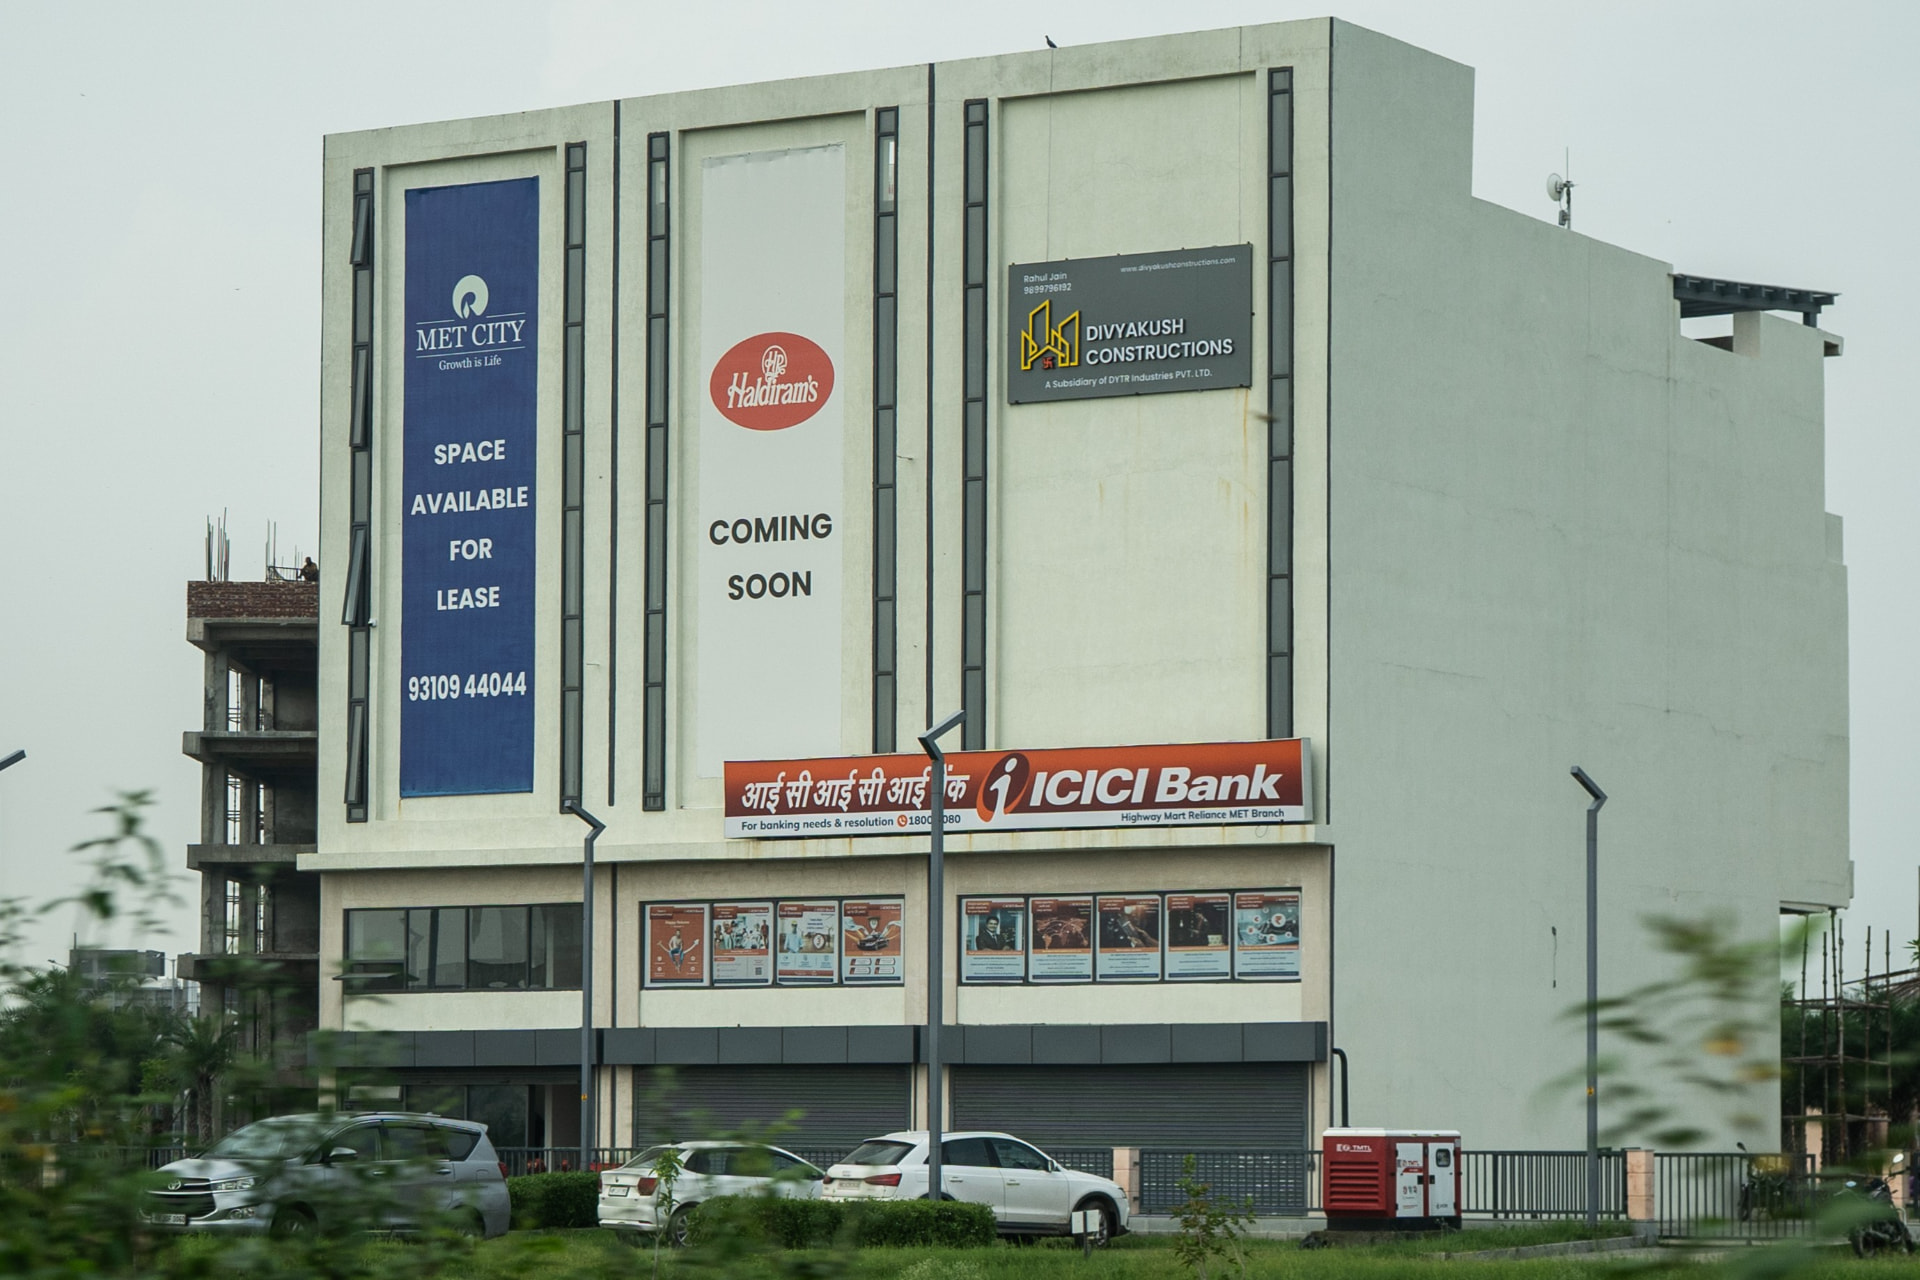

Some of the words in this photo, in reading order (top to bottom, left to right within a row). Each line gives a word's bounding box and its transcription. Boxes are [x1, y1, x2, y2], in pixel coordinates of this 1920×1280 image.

[1023, 272, 1048, 283] Rahul
[1049, 271, 1068, 281] Jain
[1120, 257, 1235, 272] www.divyakushconstructions.com
[416, 326, 467, 351] MET
[471, 319, 526, 346] CITY
[1086, 318, 1185, 341] DIVYAKUSH
[439, 357, 473, 371] Growth
[474, 356, 482, 368] is
[484, 354, 502, 367] Life
[1086, 338, 1233, 365] CONSTRUCTIONS
[727, 371, 818, 409] Haldiram's
[1044, 381, 1052, 389] A
[1052, 377, 1097, 389] Subsidiary
[1098, 375, 1108, 385] of
[1108, 373, 1130, 384] DYTR
[1131, 371, 1174, 382] Industries
[1175, 369, 1194, 379] PVT.
[1195, 368, 1213, 378] LTD.
[434, 439, 506, 465] SPACE
[410, 486, 529, 515] AVAILABLE
[709, 513, 833, 545] COMING
[450, 538, 492, 561] FOR
[437, 586, 500, 610] LEASE
[728, 571, 812, 600] SOON
[408, 675, 461, 701] 93109
[464, 671, 527, 698] 44044
[741, 771, 786, 814] आई
[785, 769, 813, 809] सी
[813, 768, 858, 812] आई
[858, 766, 887, 807] सी
[886, 765, 932, 810] आई
[1029, 767, 1150, 807] ICICI
[1155, 764, 1283, 803] Bank
[741, 821, 757, 831] For
[760, 819, 800, 831] banking
[803, 818, 832, 828] needs
[834, 818, 842, 828] &
[844, 816, 894, 827] resolution
[1121, 812, 1162, 823] Highway
[1164, 811, 1186, 820] Mart
[1188, 810, 1226, 820] Reliance
[1229, 809, 1249, 819] MET
[1251, 808, 1284, 818] Branch
